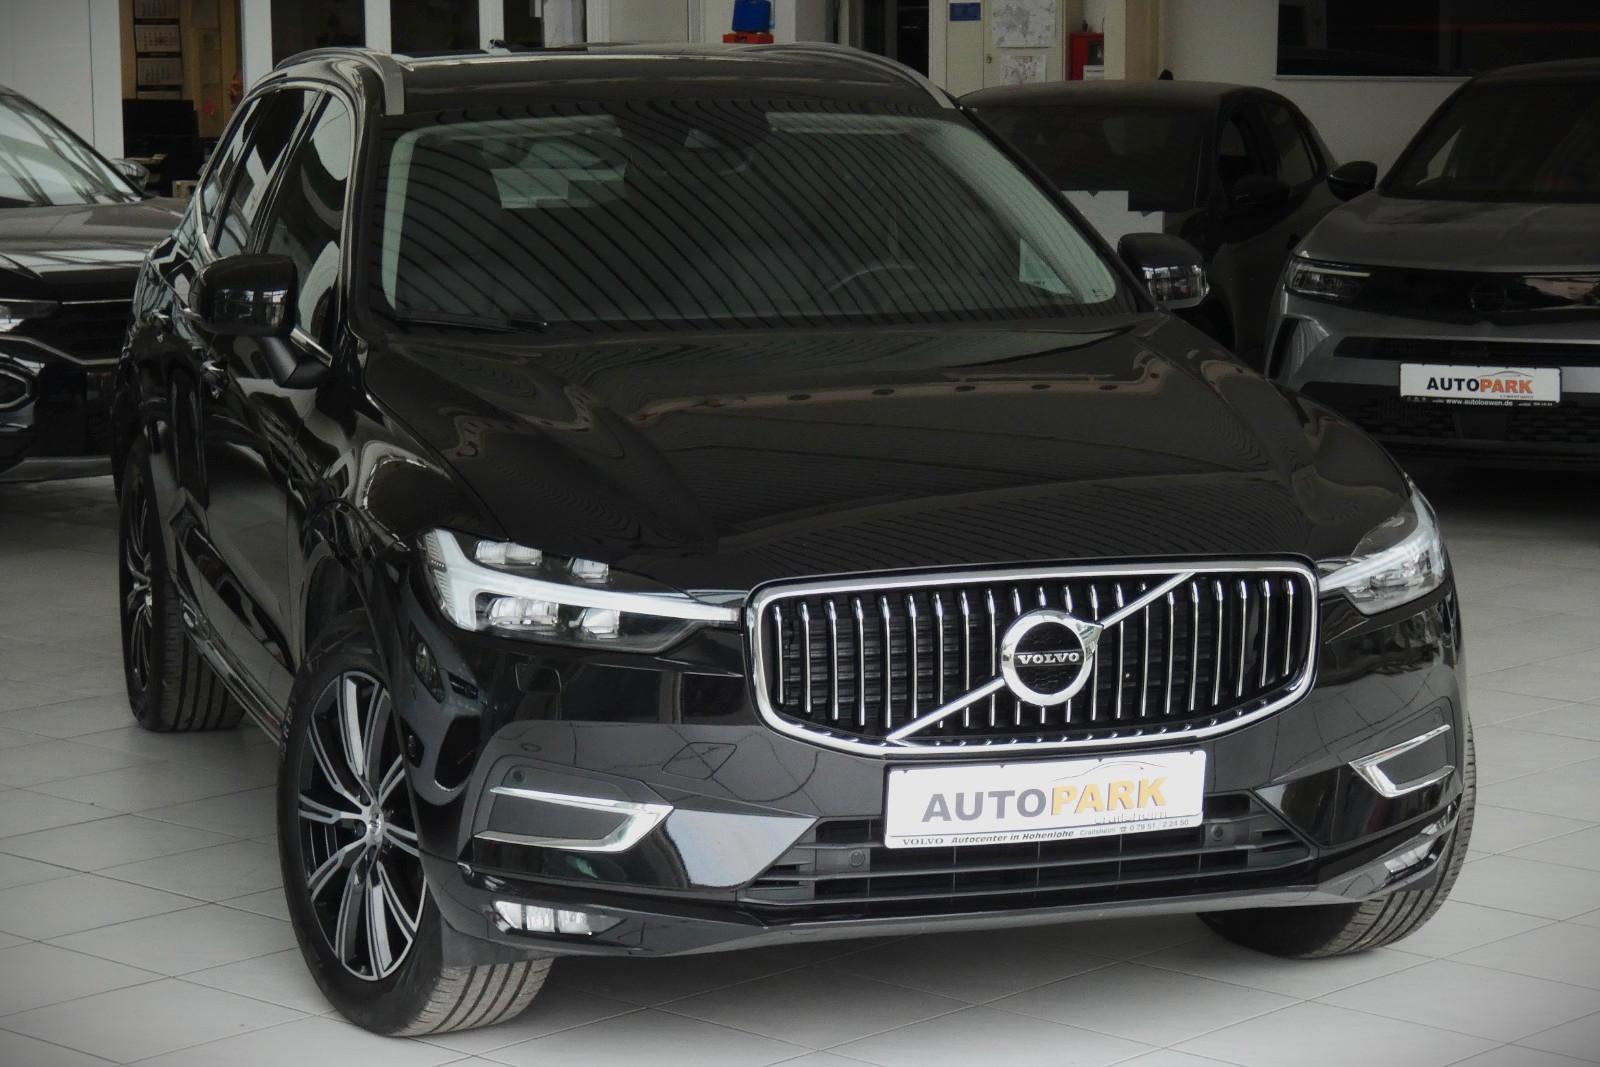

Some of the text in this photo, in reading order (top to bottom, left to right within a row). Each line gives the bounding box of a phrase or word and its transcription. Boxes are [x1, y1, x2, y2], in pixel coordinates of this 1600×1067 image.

[1426, 376, 1533, 394] AUTOPARK
[1018, 652, 1080, 665] VOLVO
[921, 777, 1168, 823] AUTOPARK
[903, 838, 944, 846] VOLVO
[951, 833, 1007, 844] Autocenter
[1010, 832, 1020, 840] in
[1022, 830, 1075, 840] Hohenlohe
